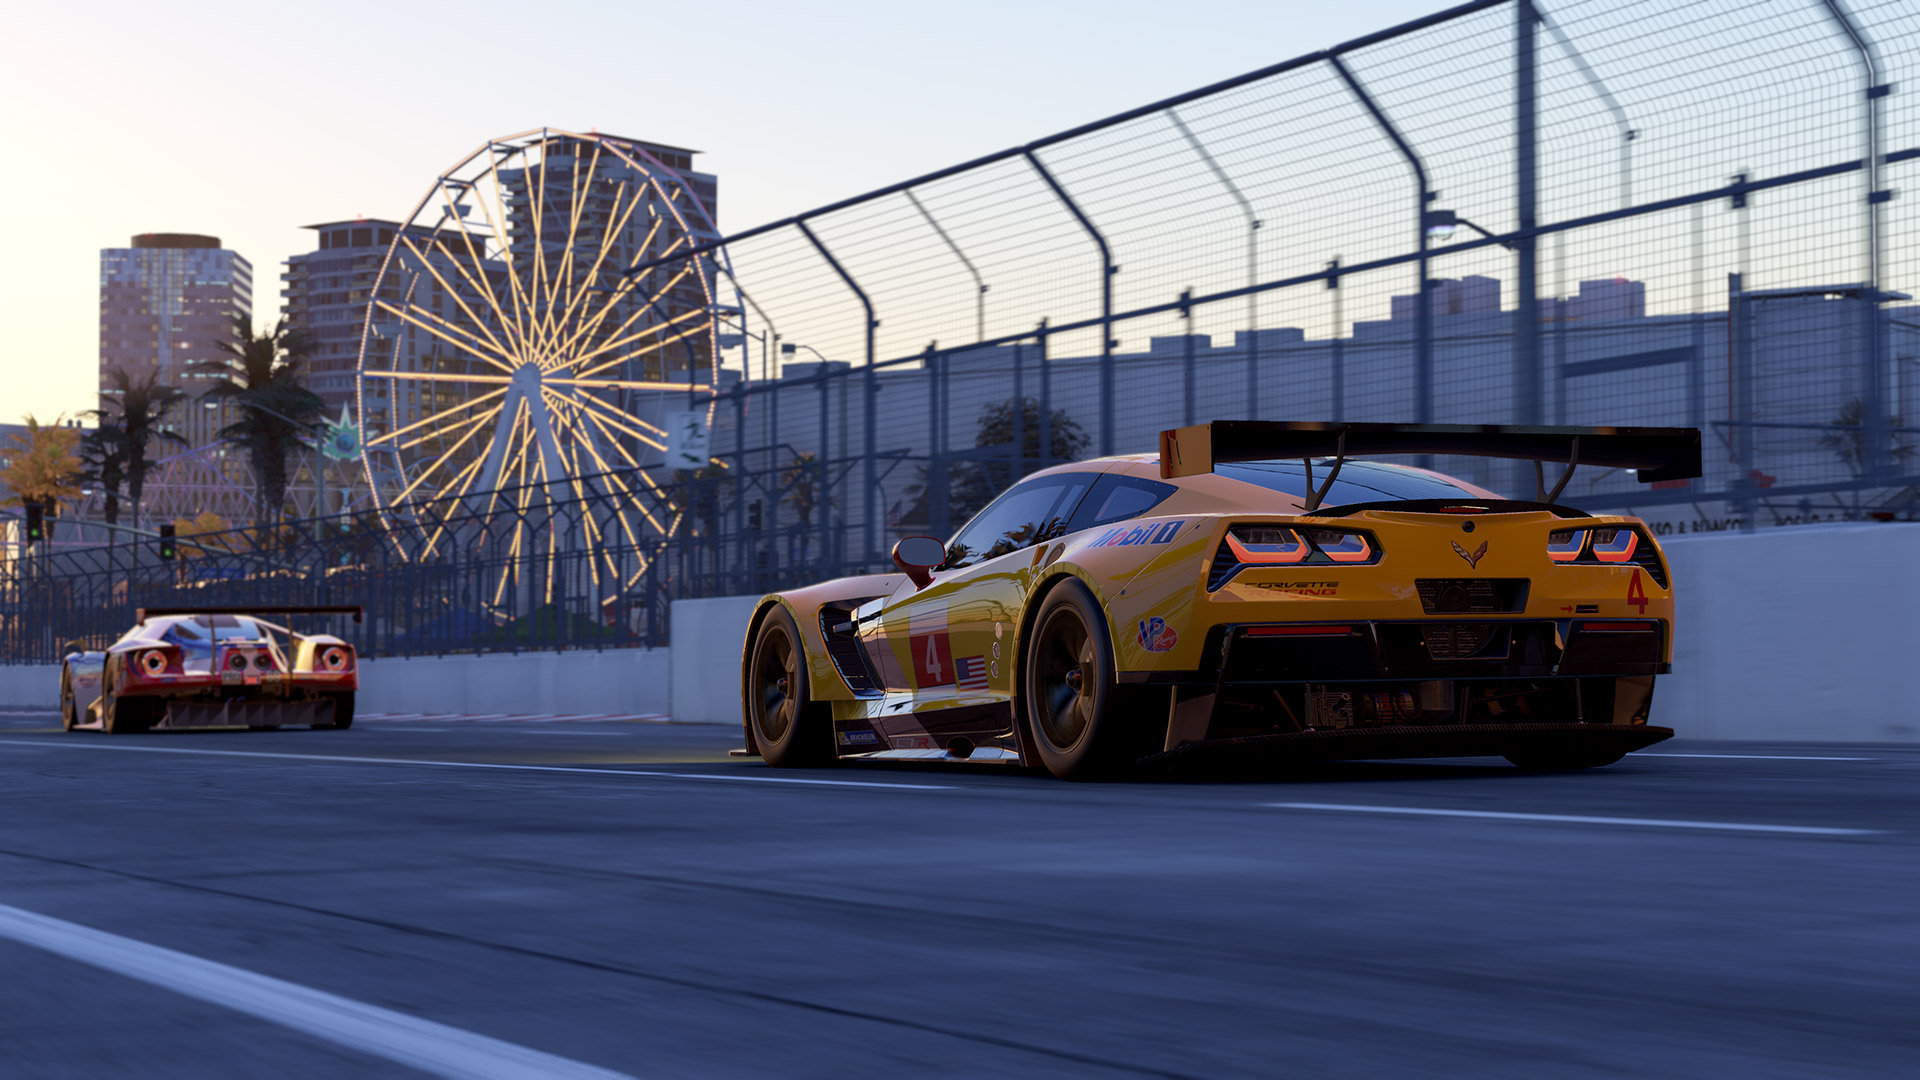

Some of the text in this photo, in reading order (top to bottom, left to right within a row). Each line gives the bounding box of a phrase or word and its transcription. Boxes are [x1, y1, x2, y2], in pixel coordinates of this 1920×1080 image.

[1087, 523, 1161, 548] Mobil
[1628, 568, 1649, 615] 4
[1139, 616, 1166, 651] VP
[926, 634, 942, 683] 4
